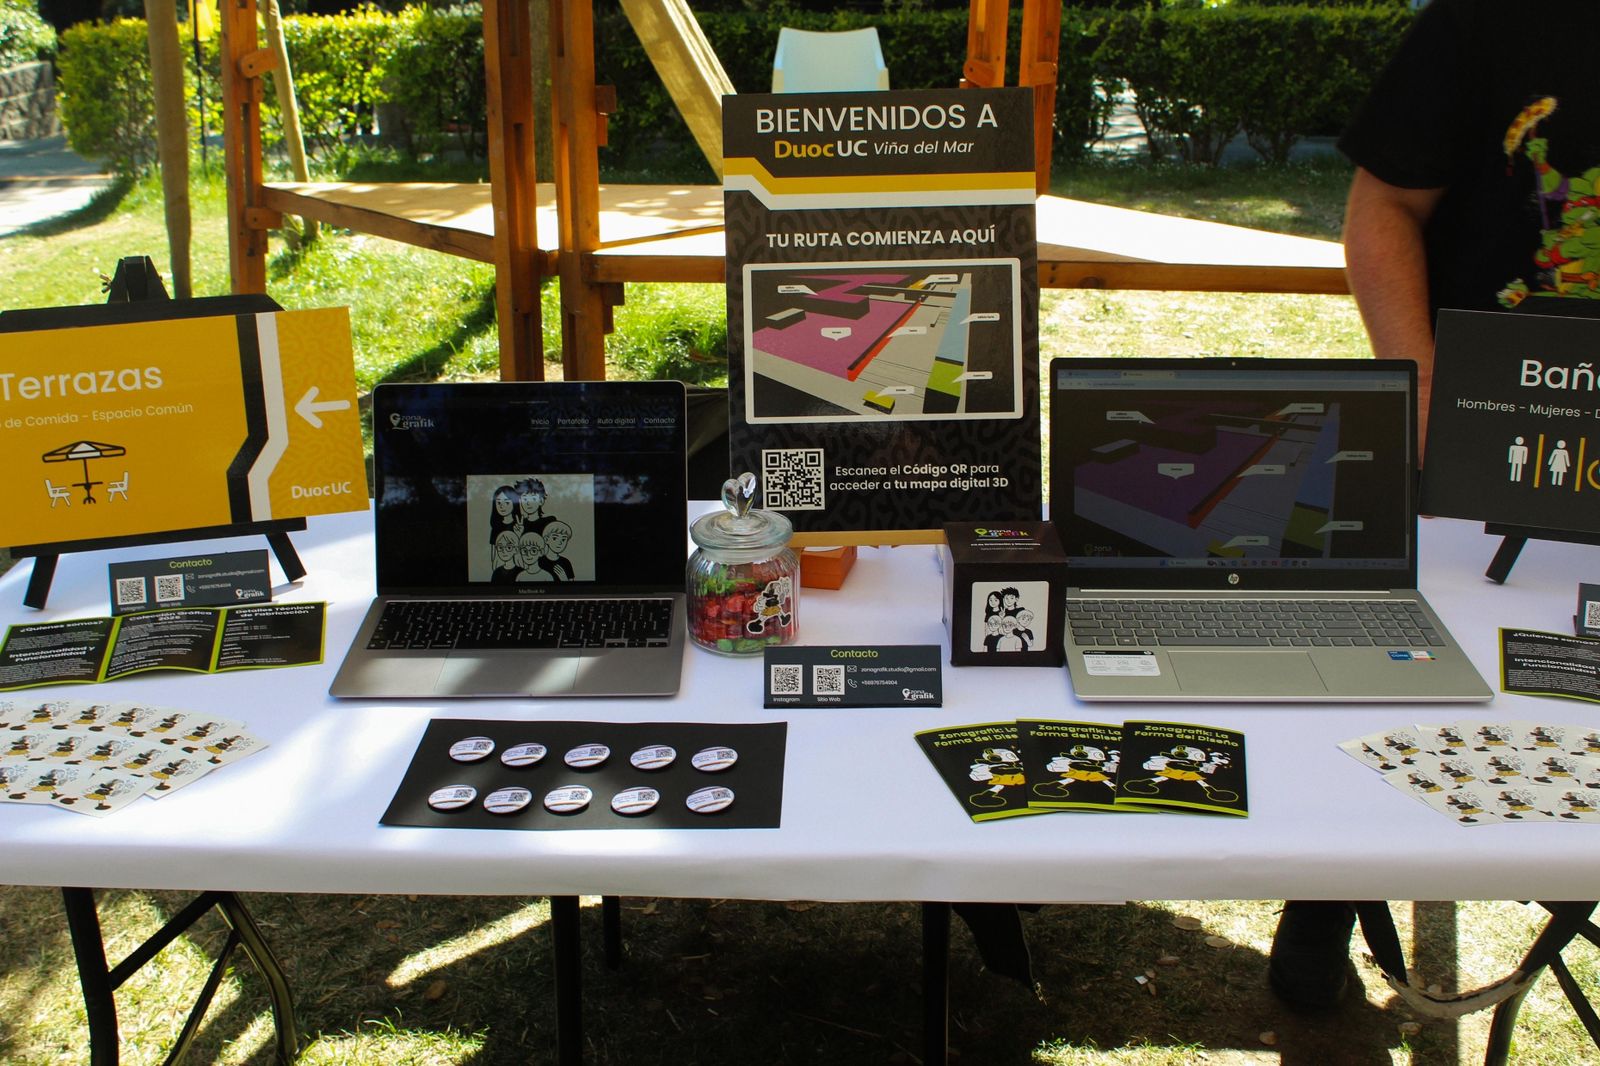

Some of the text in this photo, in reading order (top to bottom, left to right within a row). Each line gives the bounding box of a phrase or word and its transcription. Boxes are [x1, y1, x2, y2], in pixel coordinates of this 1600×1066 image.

[756, 103, 998, 134] BIENVENIDOS A
[874, 141, 908, 156] Viña
[914, 140, 939, 154] del
[943, 141, 974, 154] Mar
[766, 225, 995, 248] TU RUTA COMIENZA AQUÍ
[1520, 359, 1600, 391] Bañ
[0, 366, 163, 400] Terrazas
[1457, 398, 1516, 412] Hombres
[1530, 404, 1581, 418] Mujeres
[4, 418, 22, 429] de
[25, 412, 78, 427] Comida
[92, 407, 142, 422] Espacio
[145, 403, 193, 416] Común
[614, 417, 636, 425] digital
[403, 419, 434, 430] grafik
[835, 463, 999, 477] Escanea el Código QR para
[830, 480, 879, 490] acceder
[894, 480, 907, 489] tu
[910, 480, 947, 492] mapa
[950, 478, 989, 490] digital
[992, 478, 1008, 487] 3D
[169, 558, 212, 569] Contacto
[9, 646, 87, 658] Intencionalidad
[15, 651, 86, 662] Funcionalidad
[830, 649, 879, 658] Contacto
[1514, 658, 1596, 670] Intencionalidad
[1522, 663, 1597, 674] Funcionalidad
[911, 692, 934, 700] grafik
[1030, 730, 1068, 738] Forma
[1134, 730, 1239, 747] Forma del Diseño
[934, 738, 972, 747] Forma
